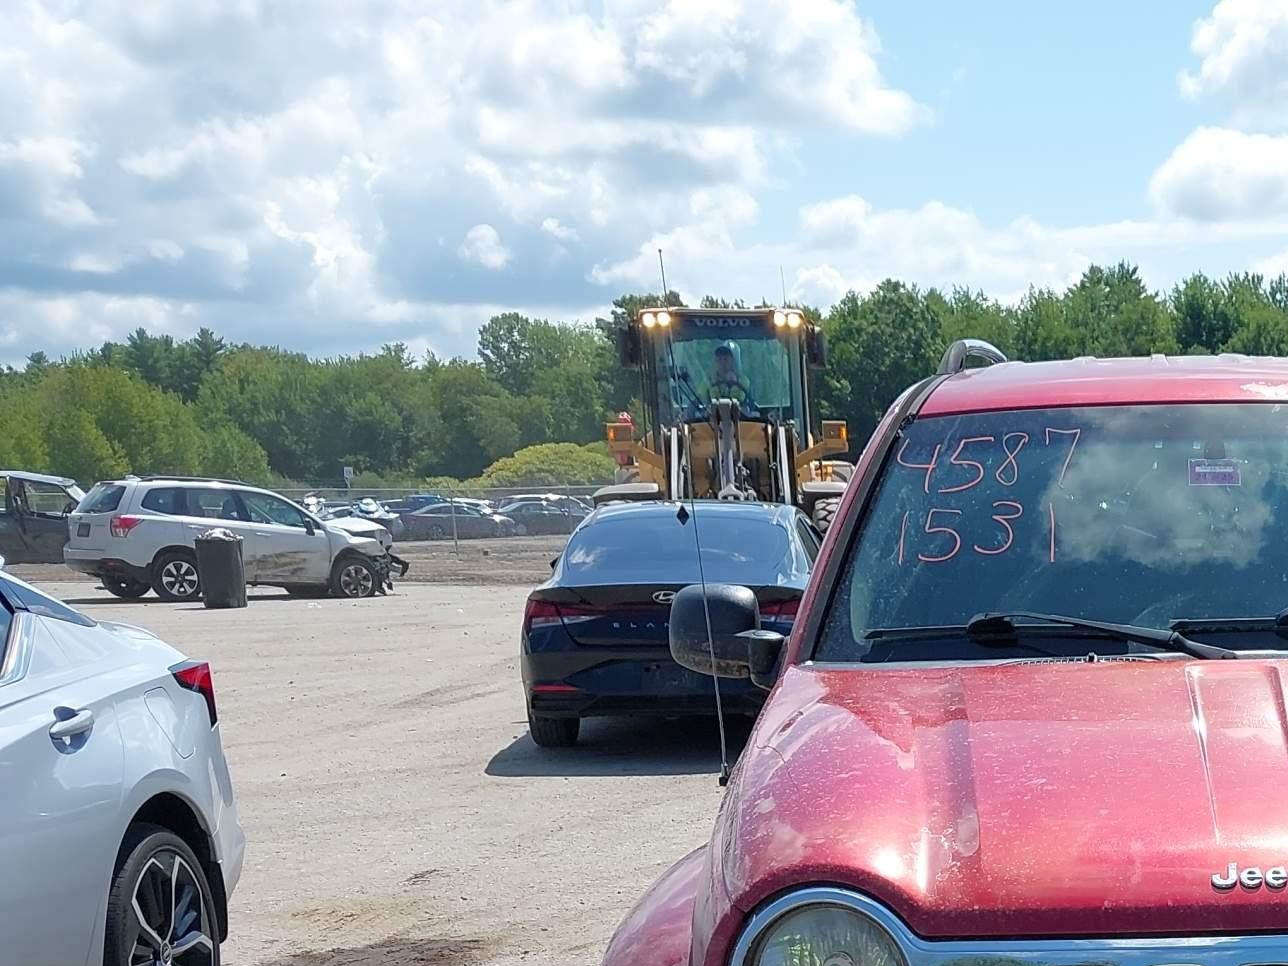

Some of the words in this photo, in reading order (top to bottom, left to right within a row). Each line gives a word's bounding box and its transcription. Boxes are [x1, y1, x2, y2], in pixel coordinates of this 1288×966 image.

[695, 318, 751, 328] VOLVO
[896, 427, 1081, 494] 4587
[897, 501, 1056, 565] 1531
